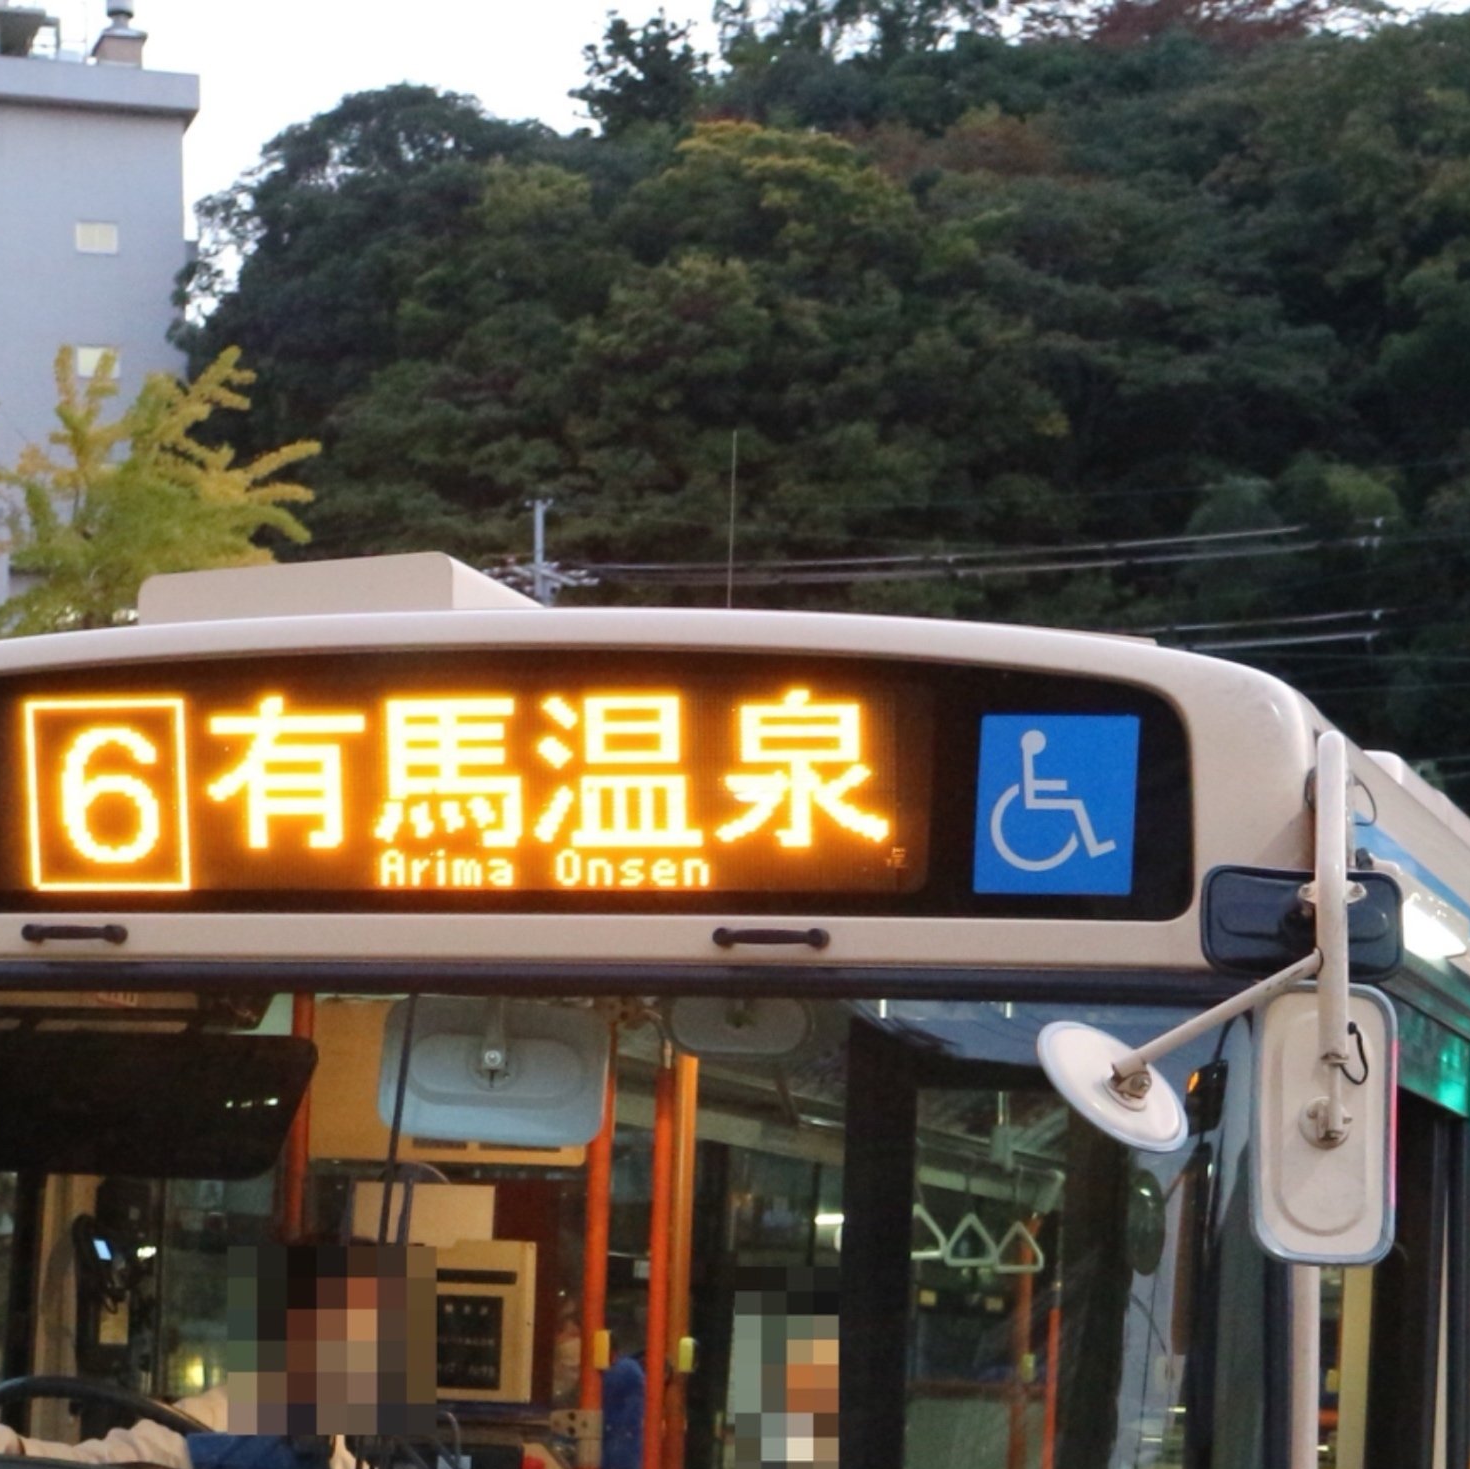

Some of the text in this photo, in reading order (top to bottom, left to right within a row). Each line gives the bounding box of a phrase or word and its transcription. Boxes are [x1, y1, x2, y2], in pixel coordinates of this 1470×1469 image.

[61, 690, 890, 862] 6 有馬温泉
[380, 850, 710, 888] Arima Onsen
